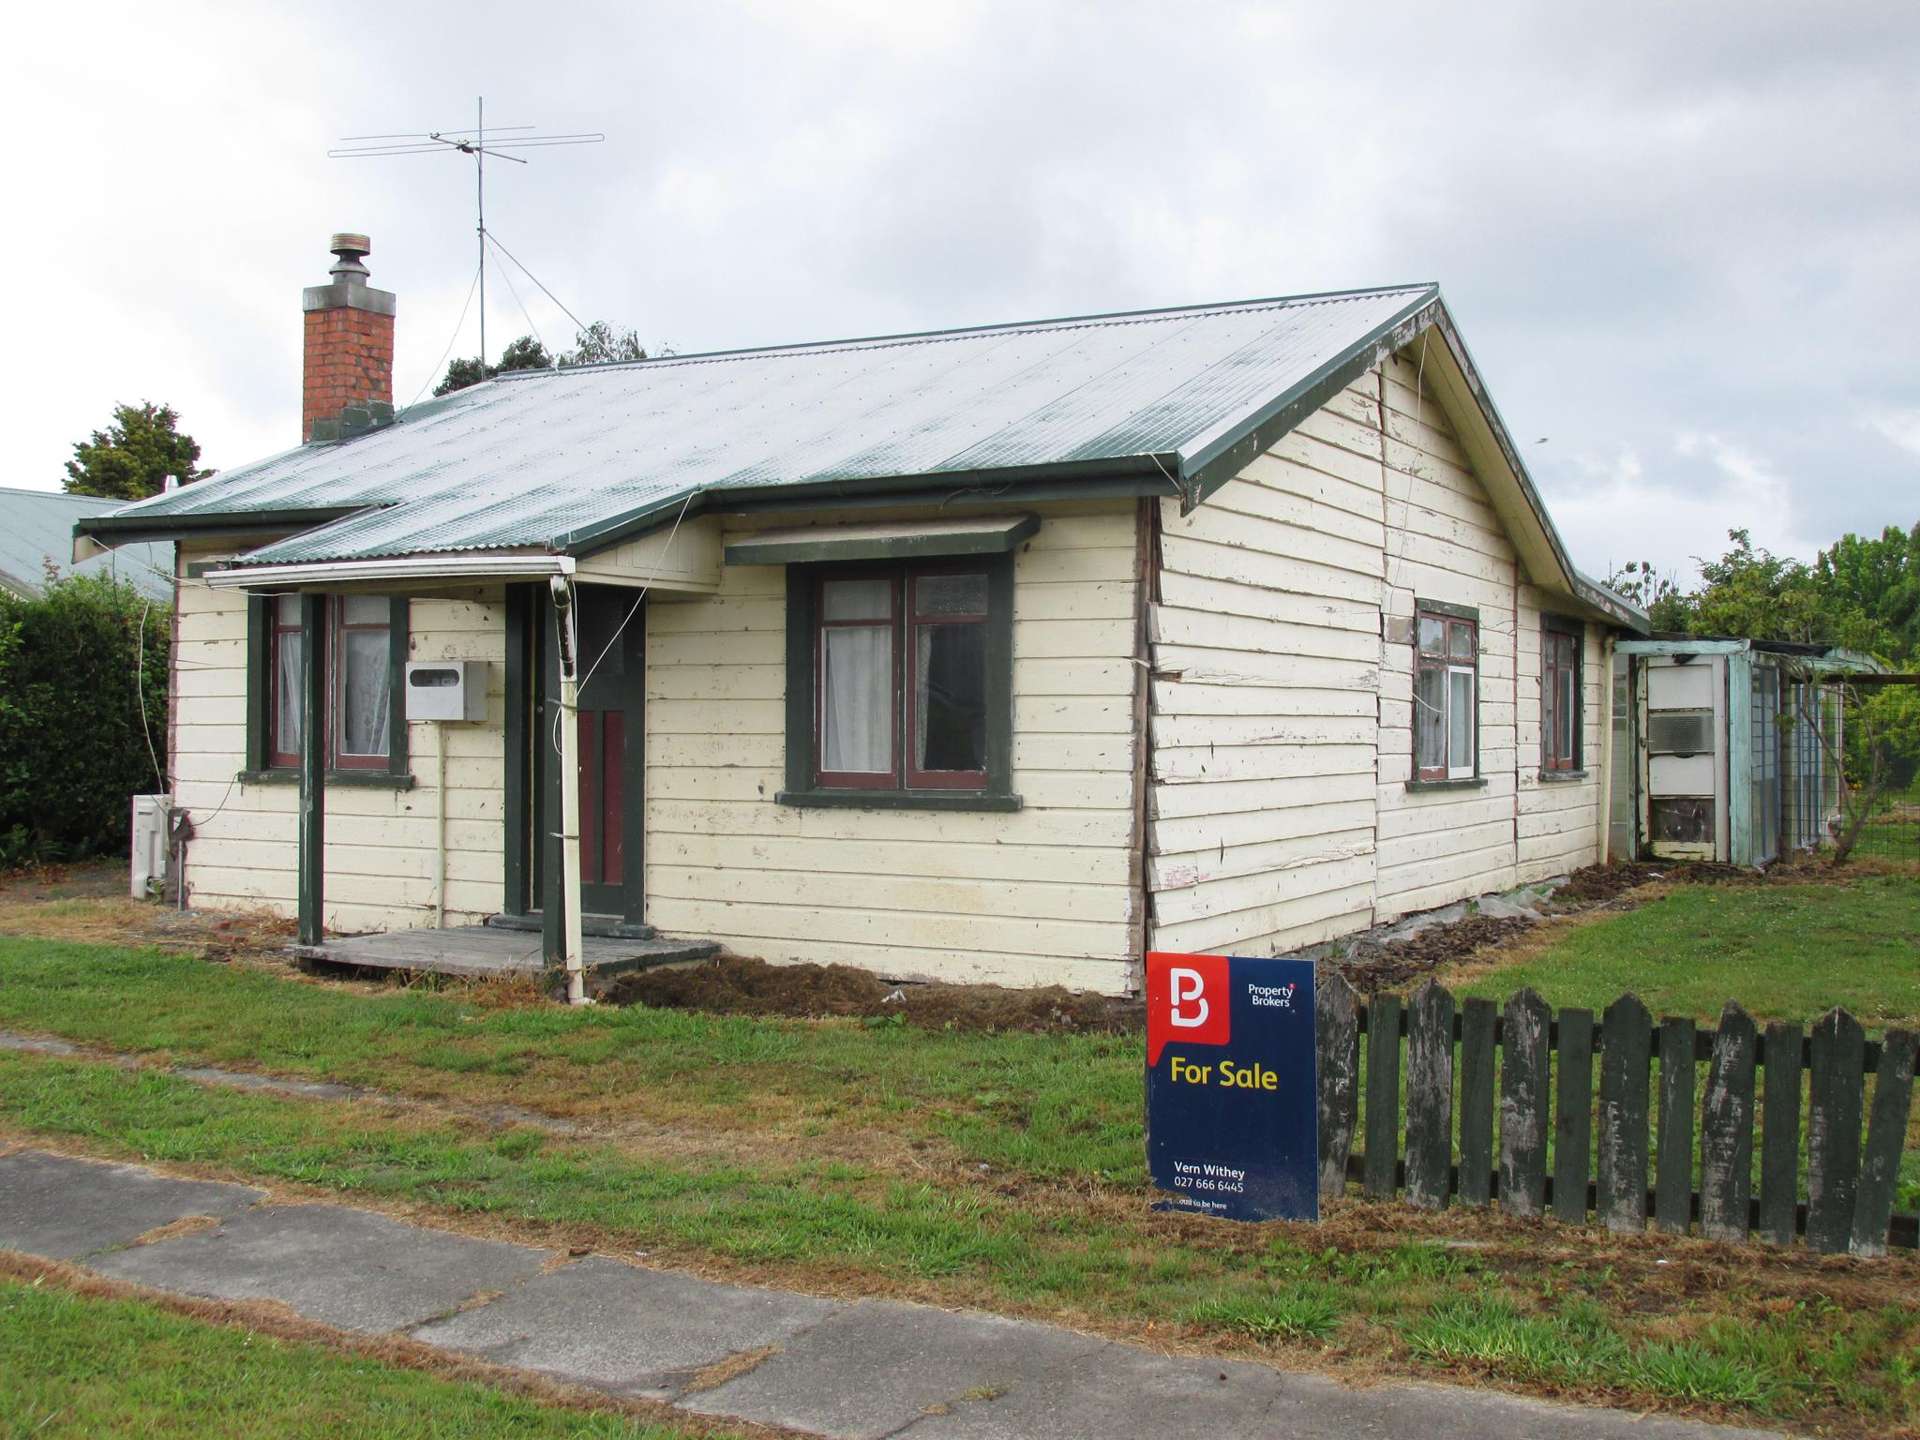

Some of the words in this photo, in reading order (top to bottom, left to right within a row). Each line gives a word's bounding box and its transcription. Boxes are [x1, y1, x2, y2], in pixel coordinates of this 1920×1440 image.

[1248, 983, 1294, 999] Property
[1252, 995, 1290, 1007] Brokers
[1171, 1056, 1212, 1085] For
[1219, 1060, 1278, 1090] Sale
[1174, 1162, 1200, 1174] Vern
[1203, 1164, 1244, 1180] Withey
[1174, 1176, 1193, 1188] 027
[1196, 1178, 1215, 1190] 666
[1218, 1180, 1244, 1193] 6445
[1202, 1200, 1211, 1208] be
[1212, 1201, 1227, 1209] here
